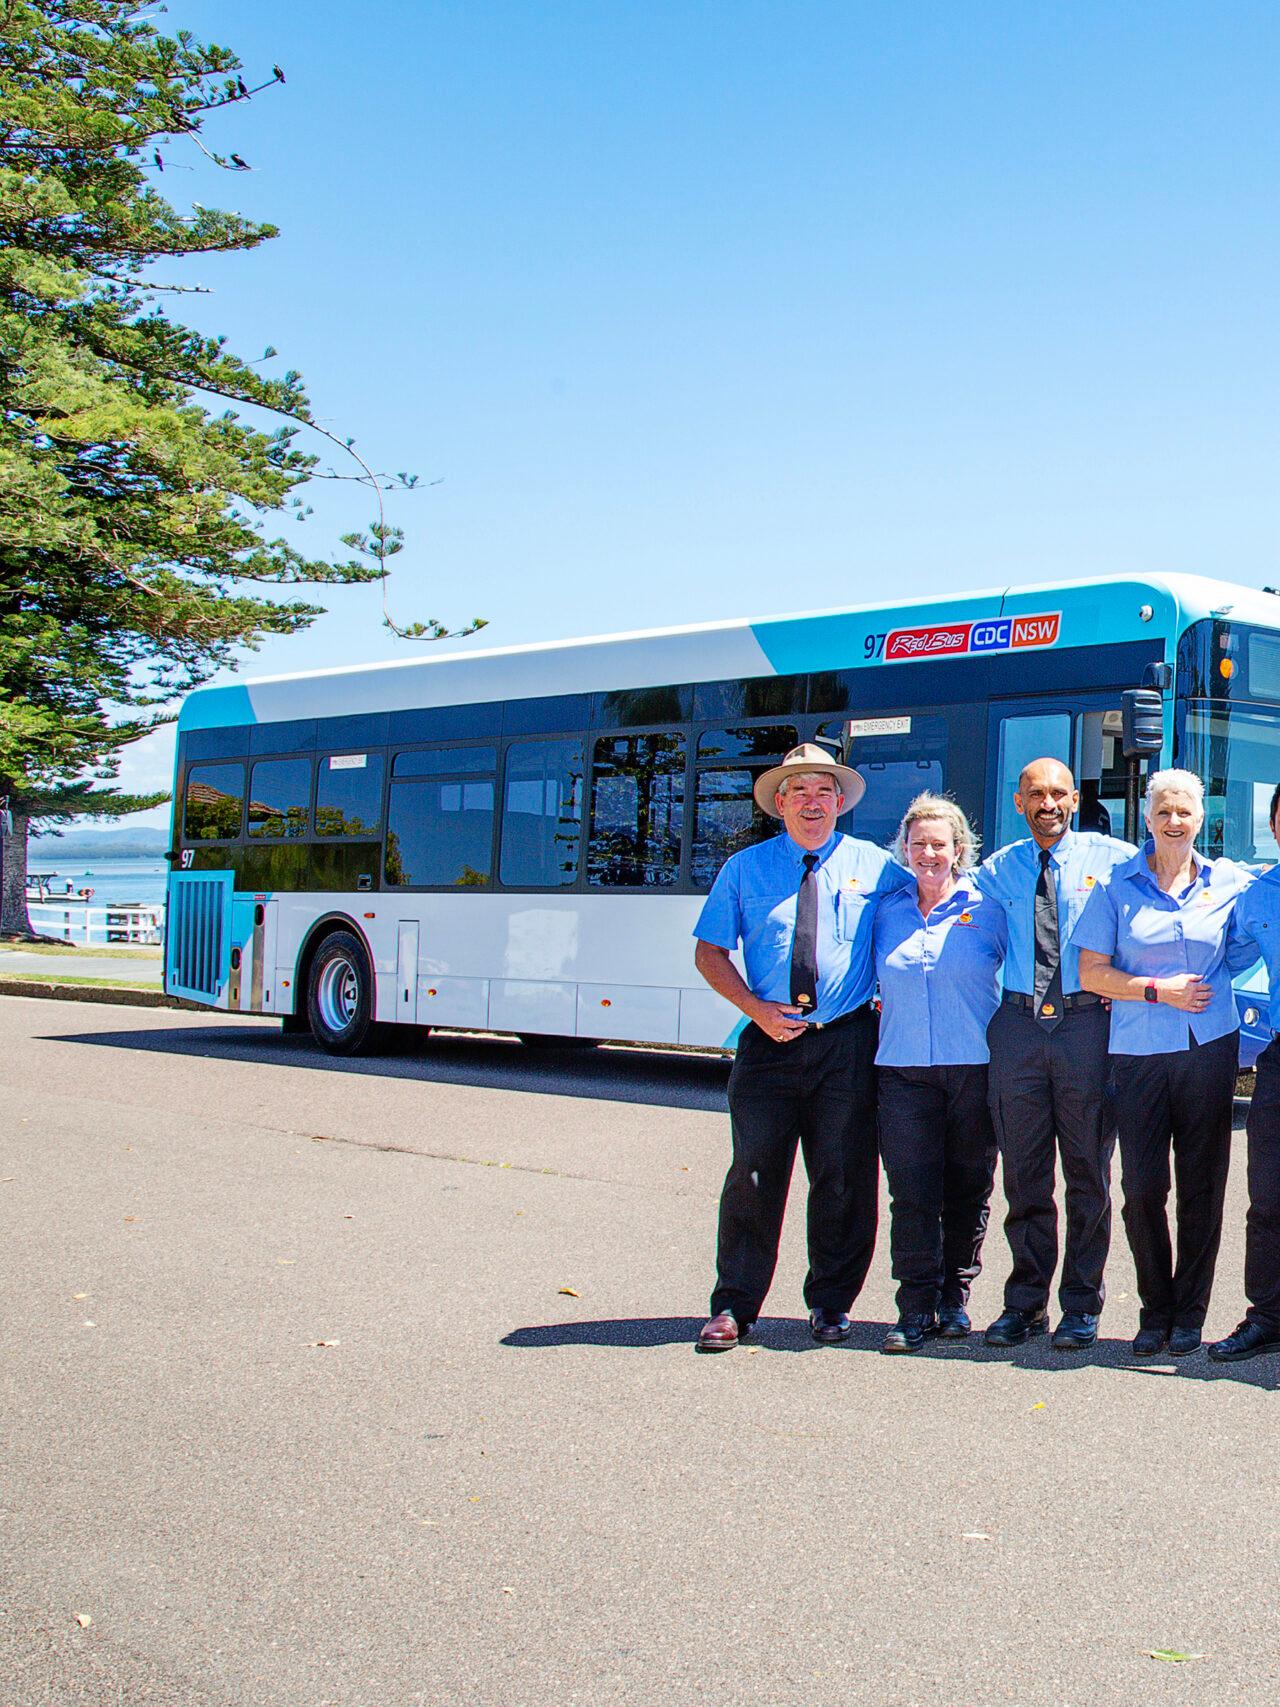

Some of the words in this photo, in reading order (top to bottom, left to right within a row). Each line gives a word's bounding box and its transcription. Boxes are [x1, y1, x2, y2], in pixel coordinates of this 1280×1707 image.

[974, 625, 1008, 646] CDC
[1015, 620, 1056, 642] NSW
[864, 634, 887, 659] 97
[863, 720, 896, 732] EMERGENCY
[181, 849, 196, 869] 97
